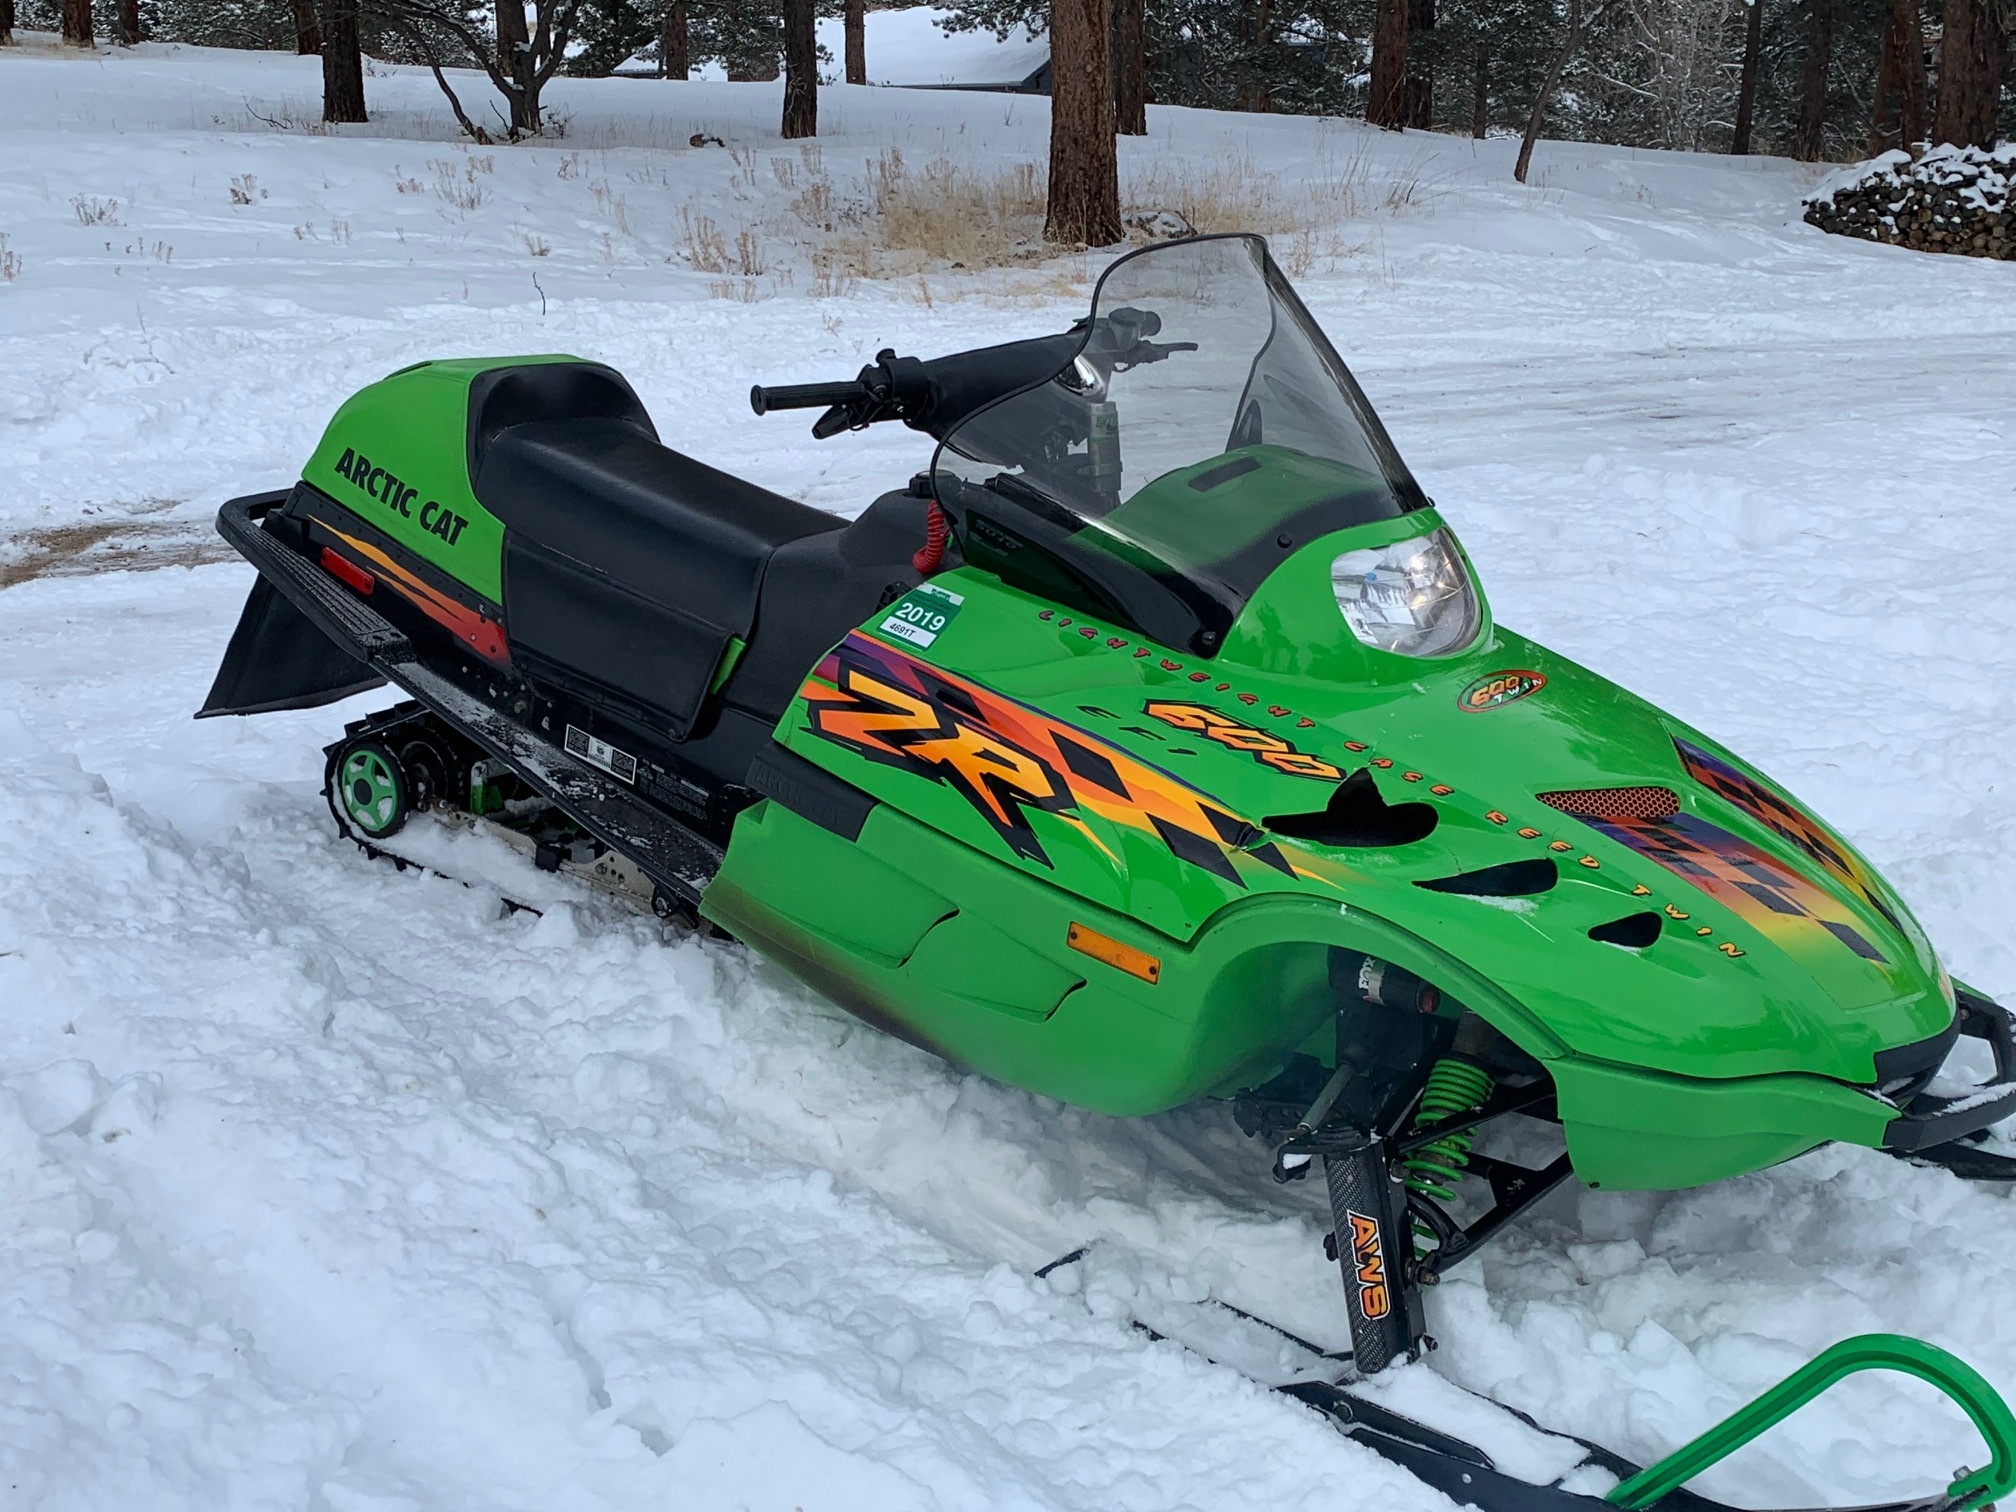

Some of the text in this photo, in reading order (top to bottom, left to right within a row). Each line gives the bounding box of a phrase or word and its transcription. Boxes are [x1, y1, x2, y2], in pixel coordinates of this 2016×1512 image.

[334, 447, 469, 546] ARCTIC CAT
[889, 622, 917, 638] 4691T
[895, 602, 946, 631] 2019
[1470, 675, 1542, 706] 600 TWIN
[806, 660, 1078, 869] ZR
[1039, 610, 1746, 958] LIGHTWEIGHT CASE REED TWIN
[1143, 699, 1346, 783] 600
[1347, 1209, 1390, 1320] AWS
